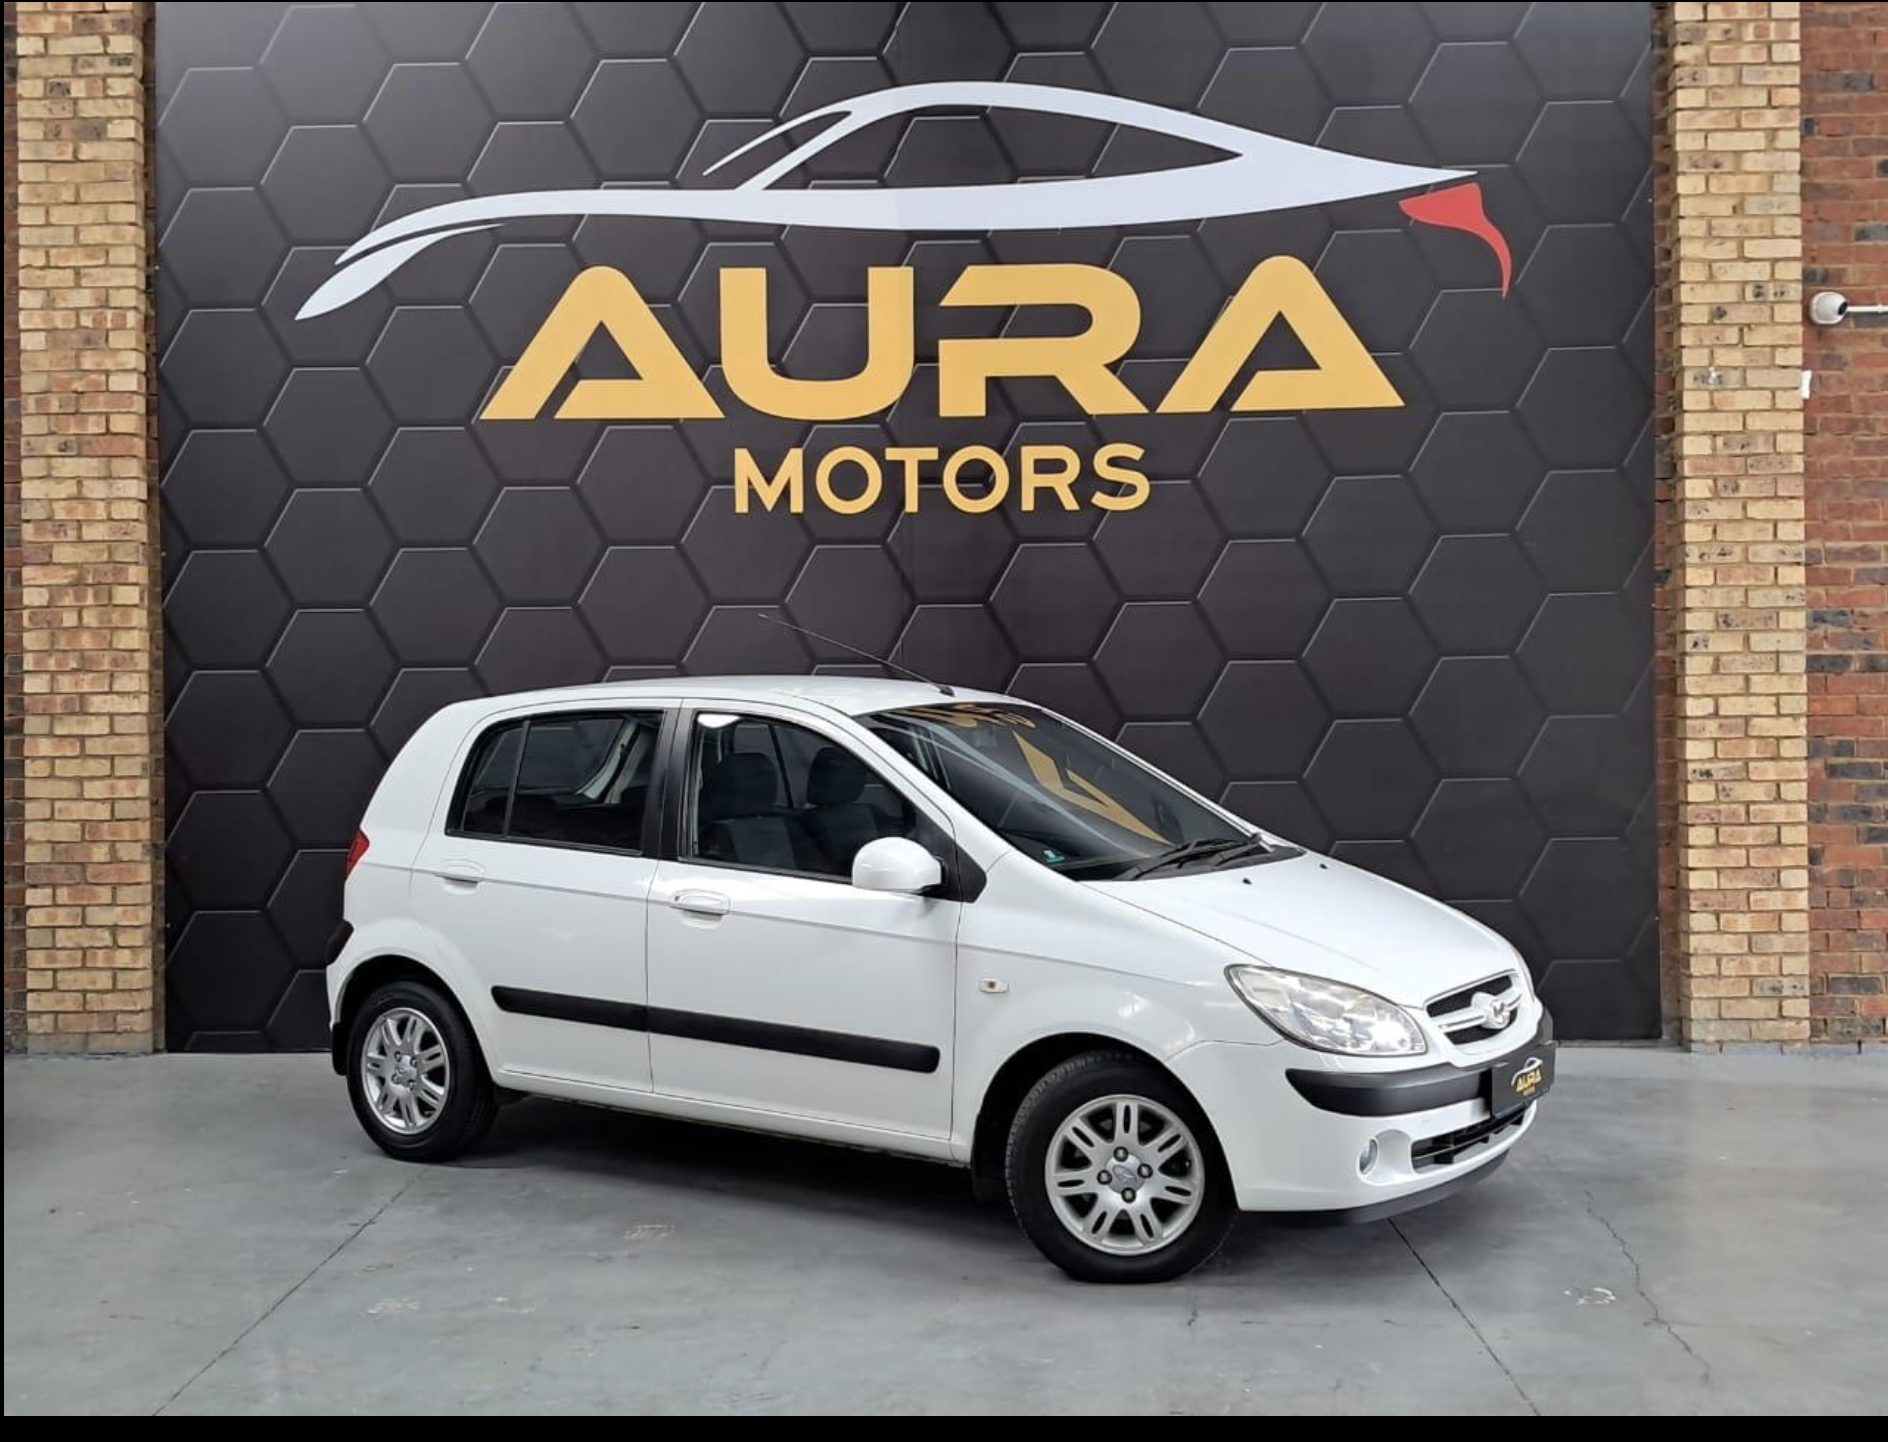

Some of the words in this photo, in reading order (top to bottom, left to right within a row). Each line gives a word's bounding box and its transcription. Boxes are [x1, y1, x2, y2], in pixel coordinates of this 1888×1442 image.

[481, 256, 1404, 421] AURA
[734, 443, 1151, 514] MOTORS
[1516, 1068, 1542, 1092] AURA
